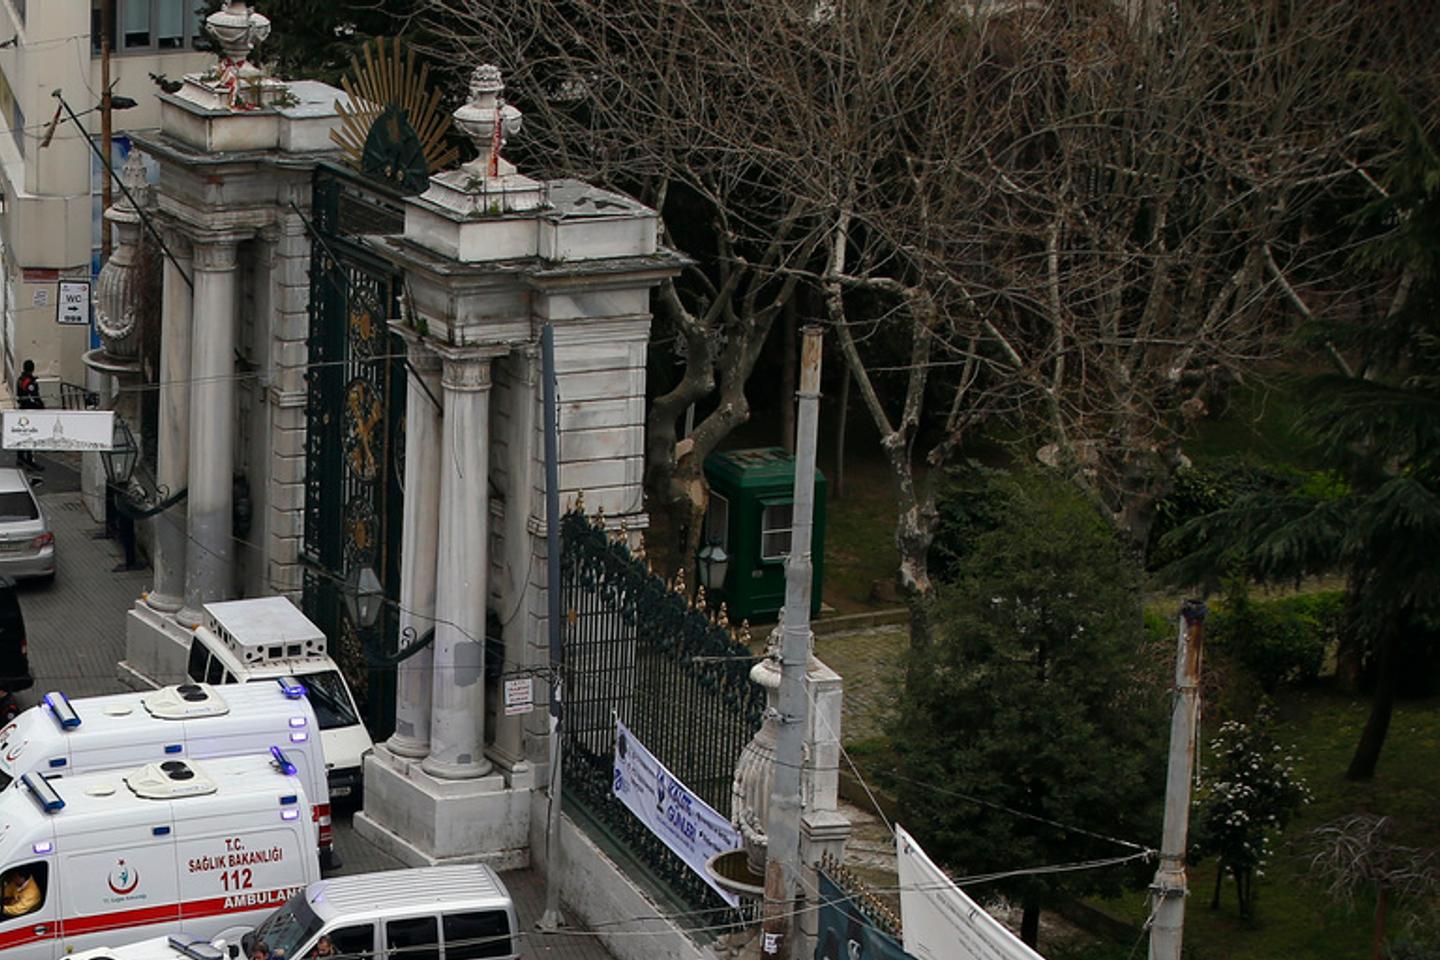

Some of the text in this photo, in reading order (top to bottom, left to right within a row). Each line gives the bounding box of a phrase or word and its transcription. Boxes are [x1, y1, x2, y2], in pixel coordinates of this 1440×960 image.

[66, 294, 82, 303] WC
[225, 839, 245, 852] T.C.
[188, 846, 282, 873] SAĞLIK BAKANLIĞI
[220, 868, 252, 891] 112
[223, 886, 308, 909] AMBULAN
